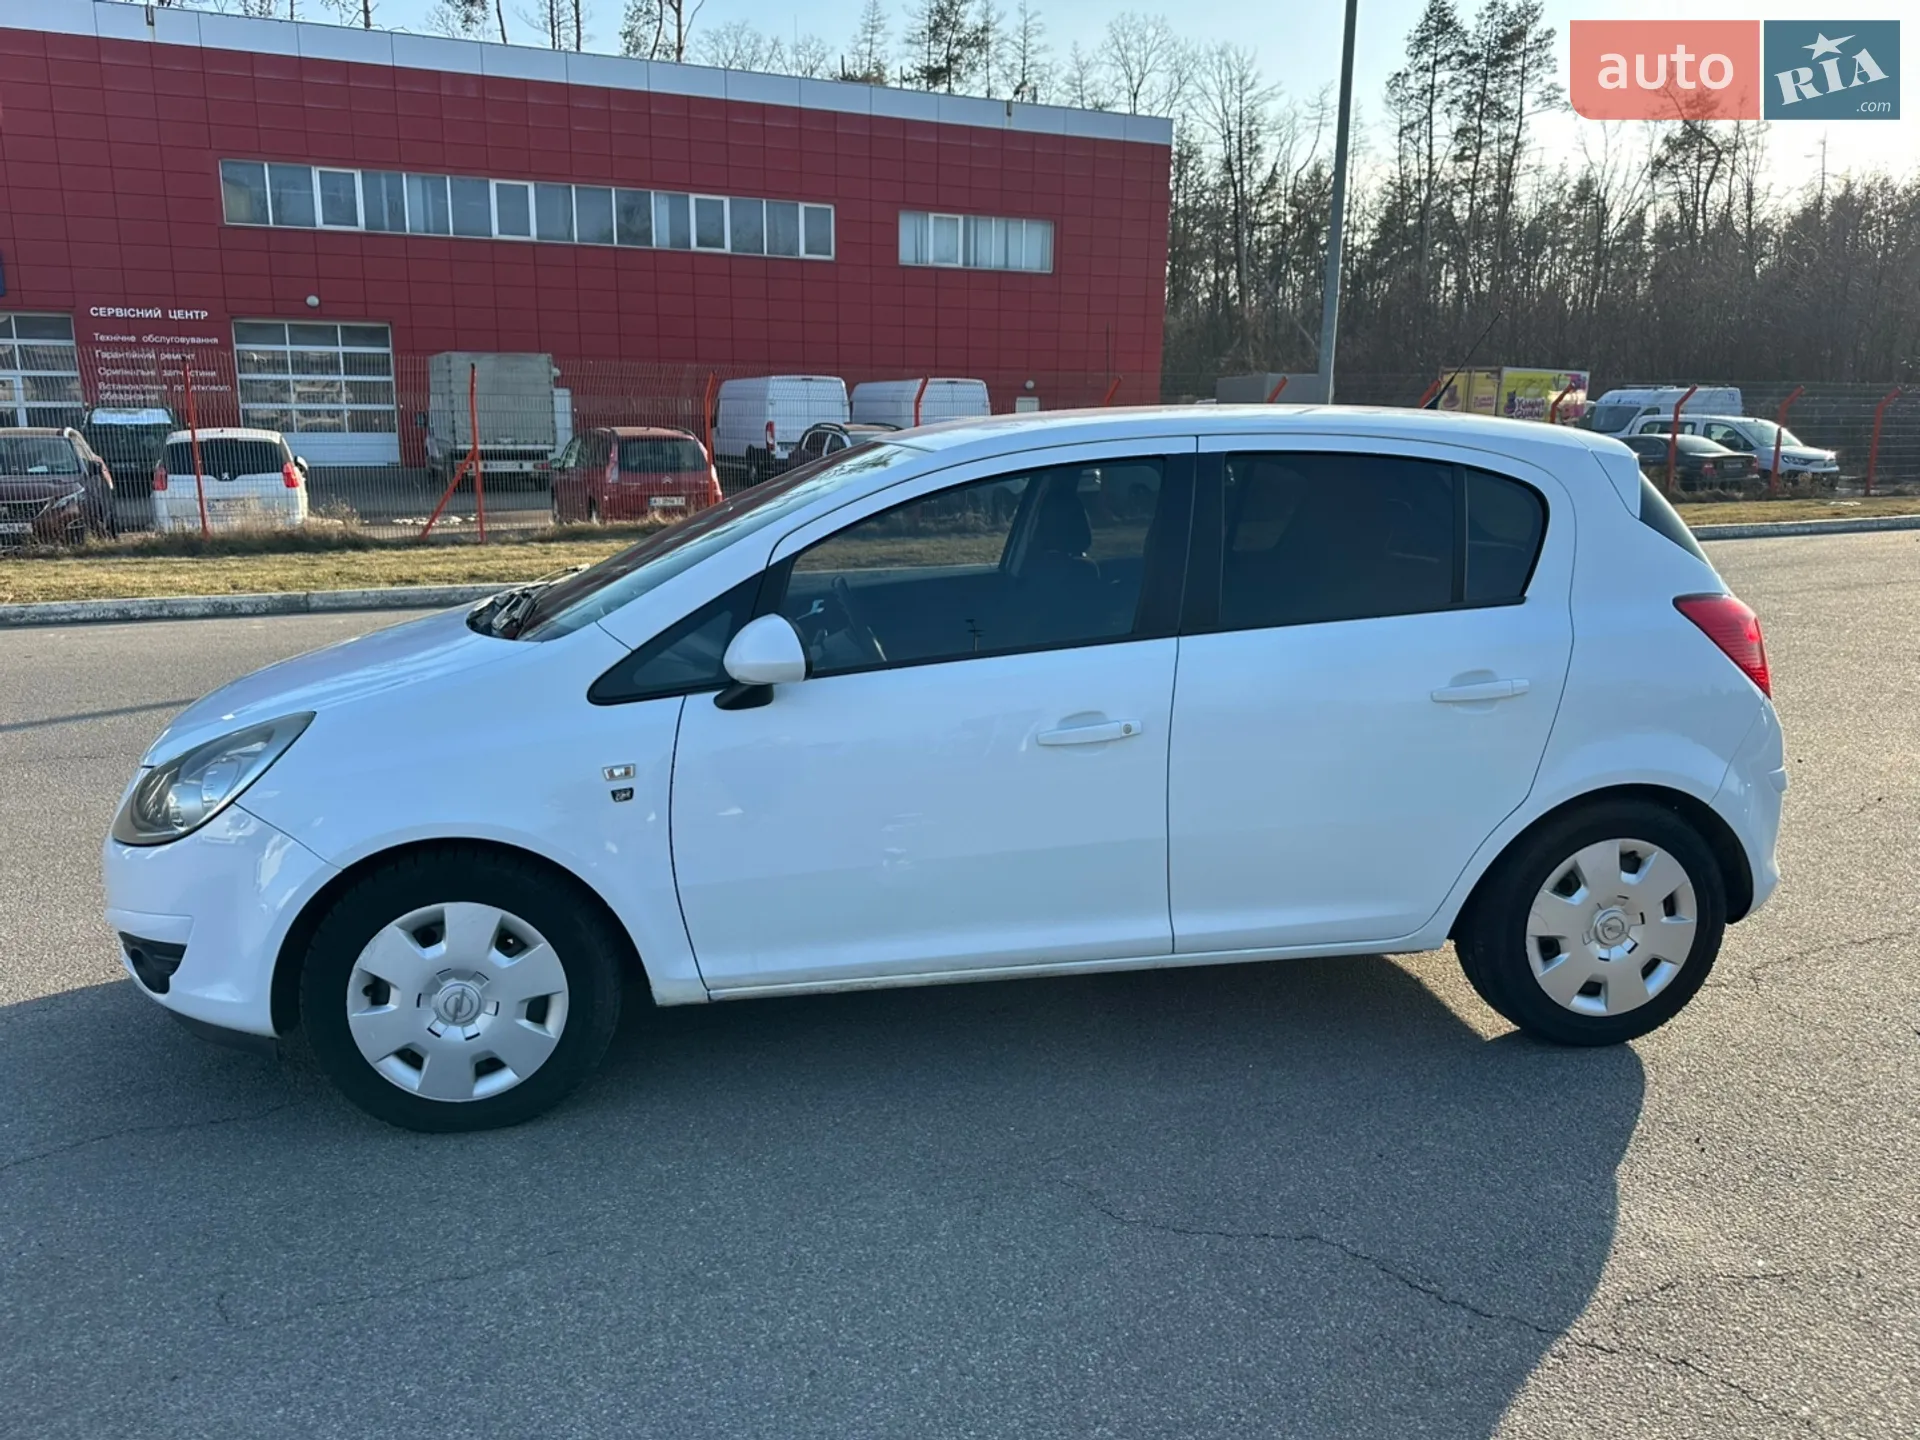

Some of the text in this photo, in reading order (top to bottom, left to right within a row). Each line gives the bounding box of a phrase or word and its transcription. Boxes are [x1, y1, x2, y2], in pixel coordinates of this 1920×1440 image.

[90, 306, 208, 320] СЕРВІСНИЙ ЦЕНТР
[93, 332, 219, 345] Технічне обслуговування
[163, 369, 216, 377] запчстини
